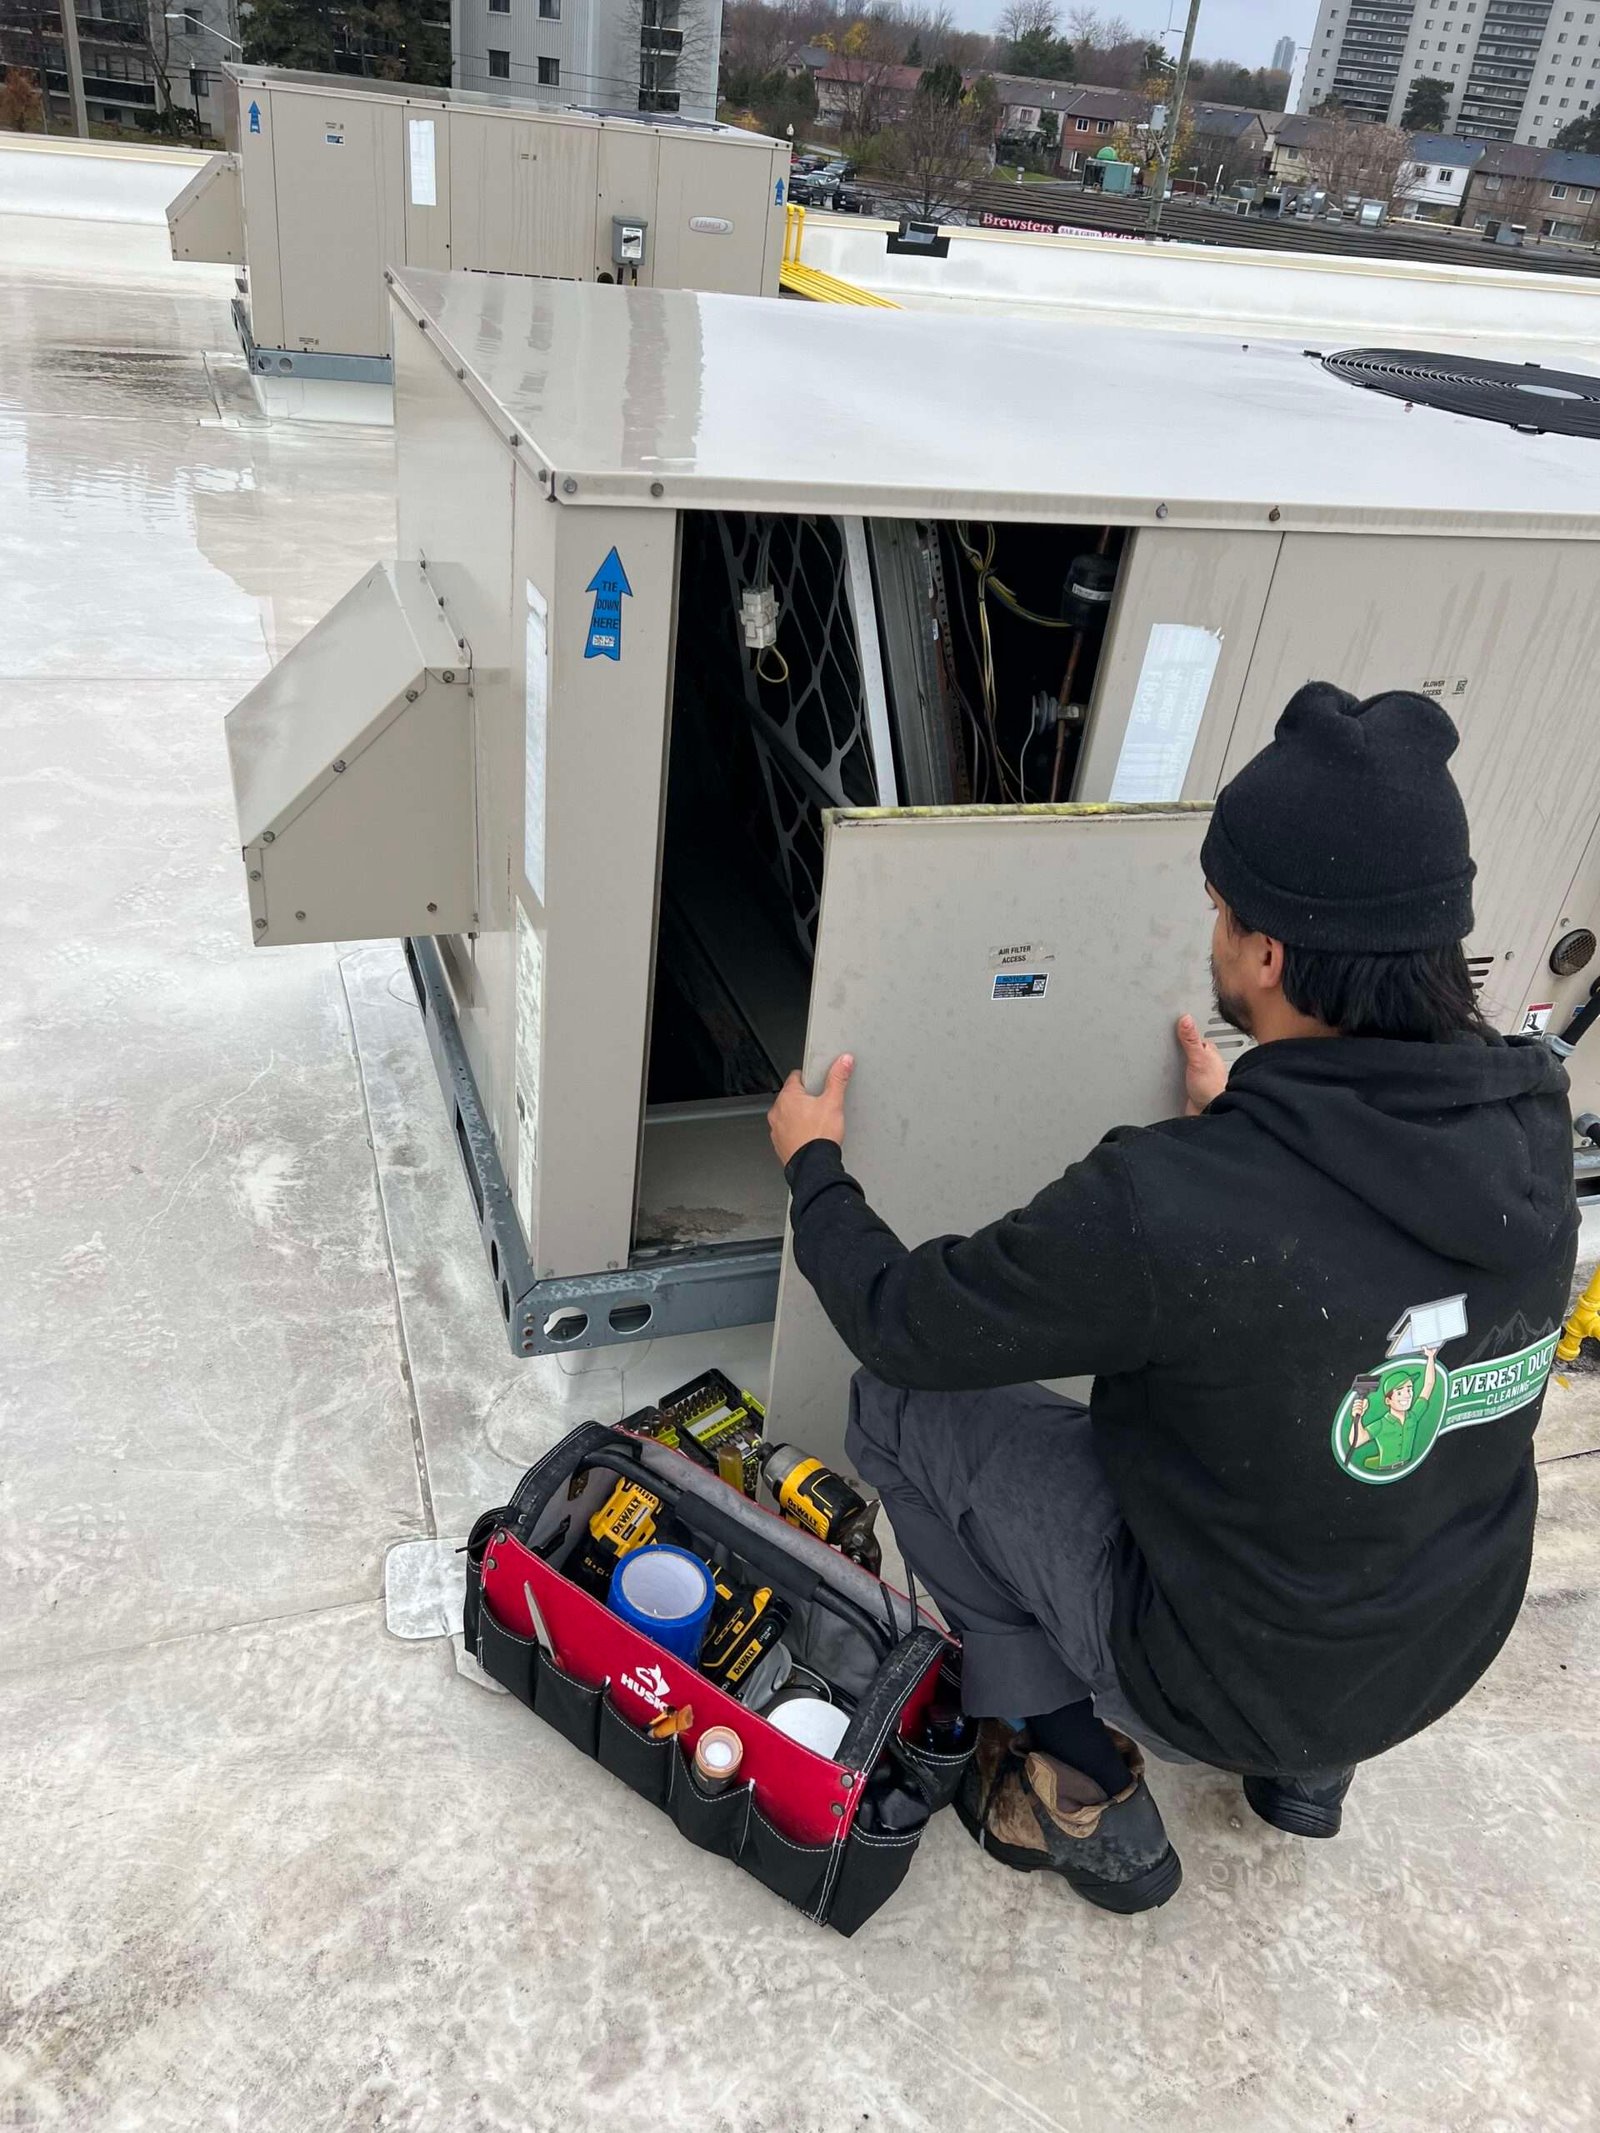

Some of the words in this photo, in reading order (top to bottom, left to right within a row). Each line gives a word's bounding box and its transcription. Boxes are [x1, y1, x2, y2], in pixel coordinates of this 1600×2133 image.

[982, 212, 1054, 234] Brewsters
[602, 581, 618, 592] TIE
[597, 600, 619, 611] DOWN
[593, 618, 619, 629] HERE
[1423, 680, 1445, 688] BLOWER
[998, 947, 1010, 956] AIR
[1010, 945, 1031, 954] FILTER
[1001, 955, 1026, 964] ACCESS
[1450, 1360, 1525, 1400] EVEREST
[1486, 1380, 1530, 1406] CLEANING
[621, 1672, 670, 1713] HUSK
